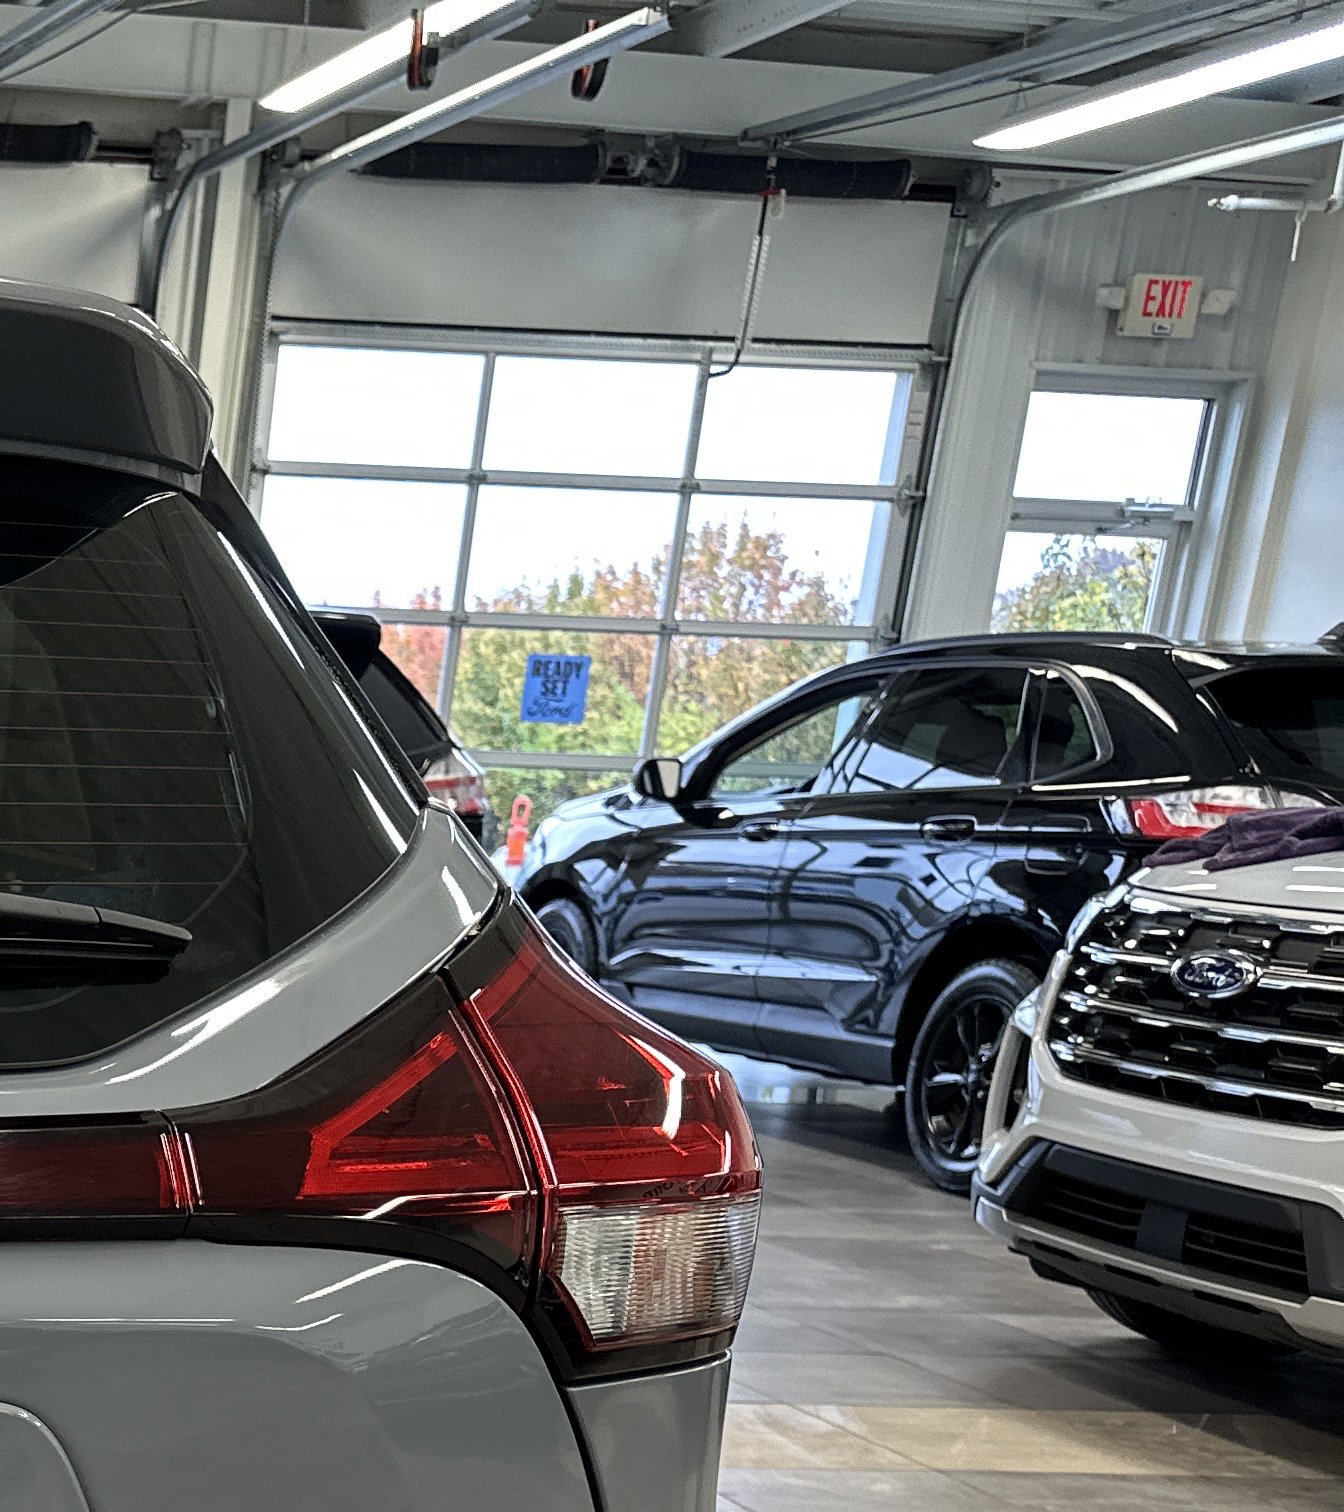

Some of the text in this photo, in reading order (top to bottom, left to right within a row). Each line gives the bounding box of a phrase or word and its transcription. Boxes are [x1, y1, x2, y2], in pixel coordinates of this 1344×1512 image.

[1141, 279, 1193, 319] EXIT
[532, 660, 584, 679] READY
[541, 680, 568, 697] SET
